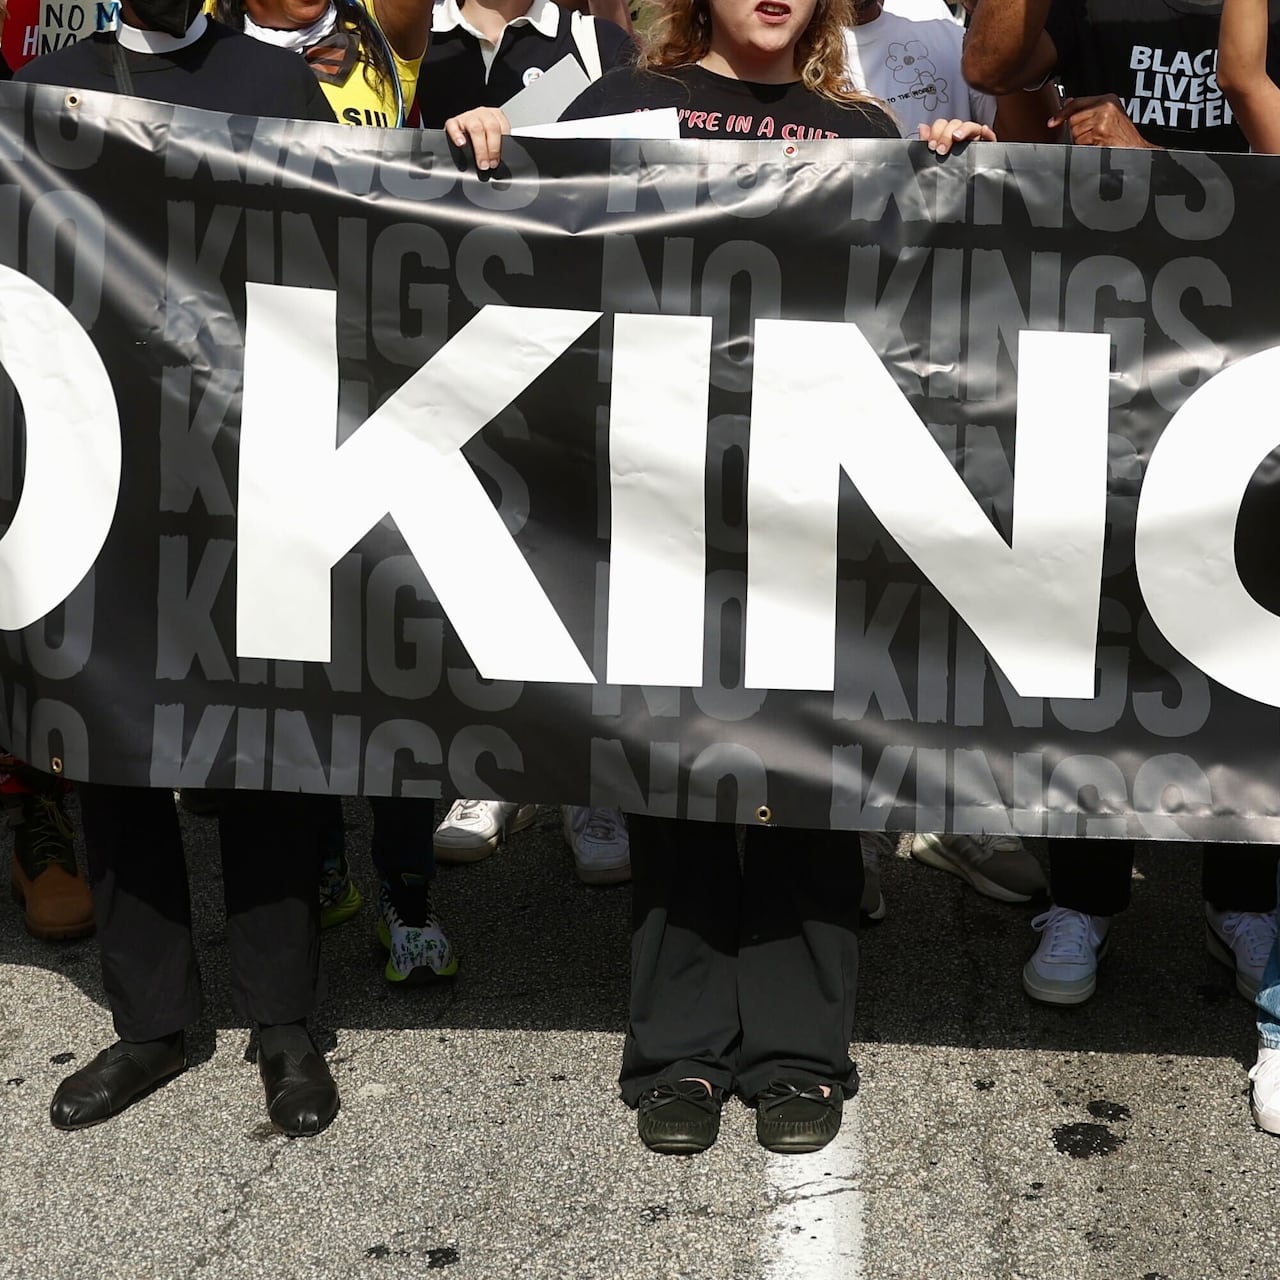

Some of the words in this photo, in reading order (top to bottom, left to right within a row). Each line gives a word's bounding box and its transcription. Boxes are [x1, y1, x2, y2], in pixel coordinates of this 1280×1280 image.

[44, 3, 85, 32] NO
[1129, 45, 1220, 76] BLAC
[1134, 71, 1224, 104] LIVES
[725, 114, 753, 133] IN
[756, 117, 776, 138] A
